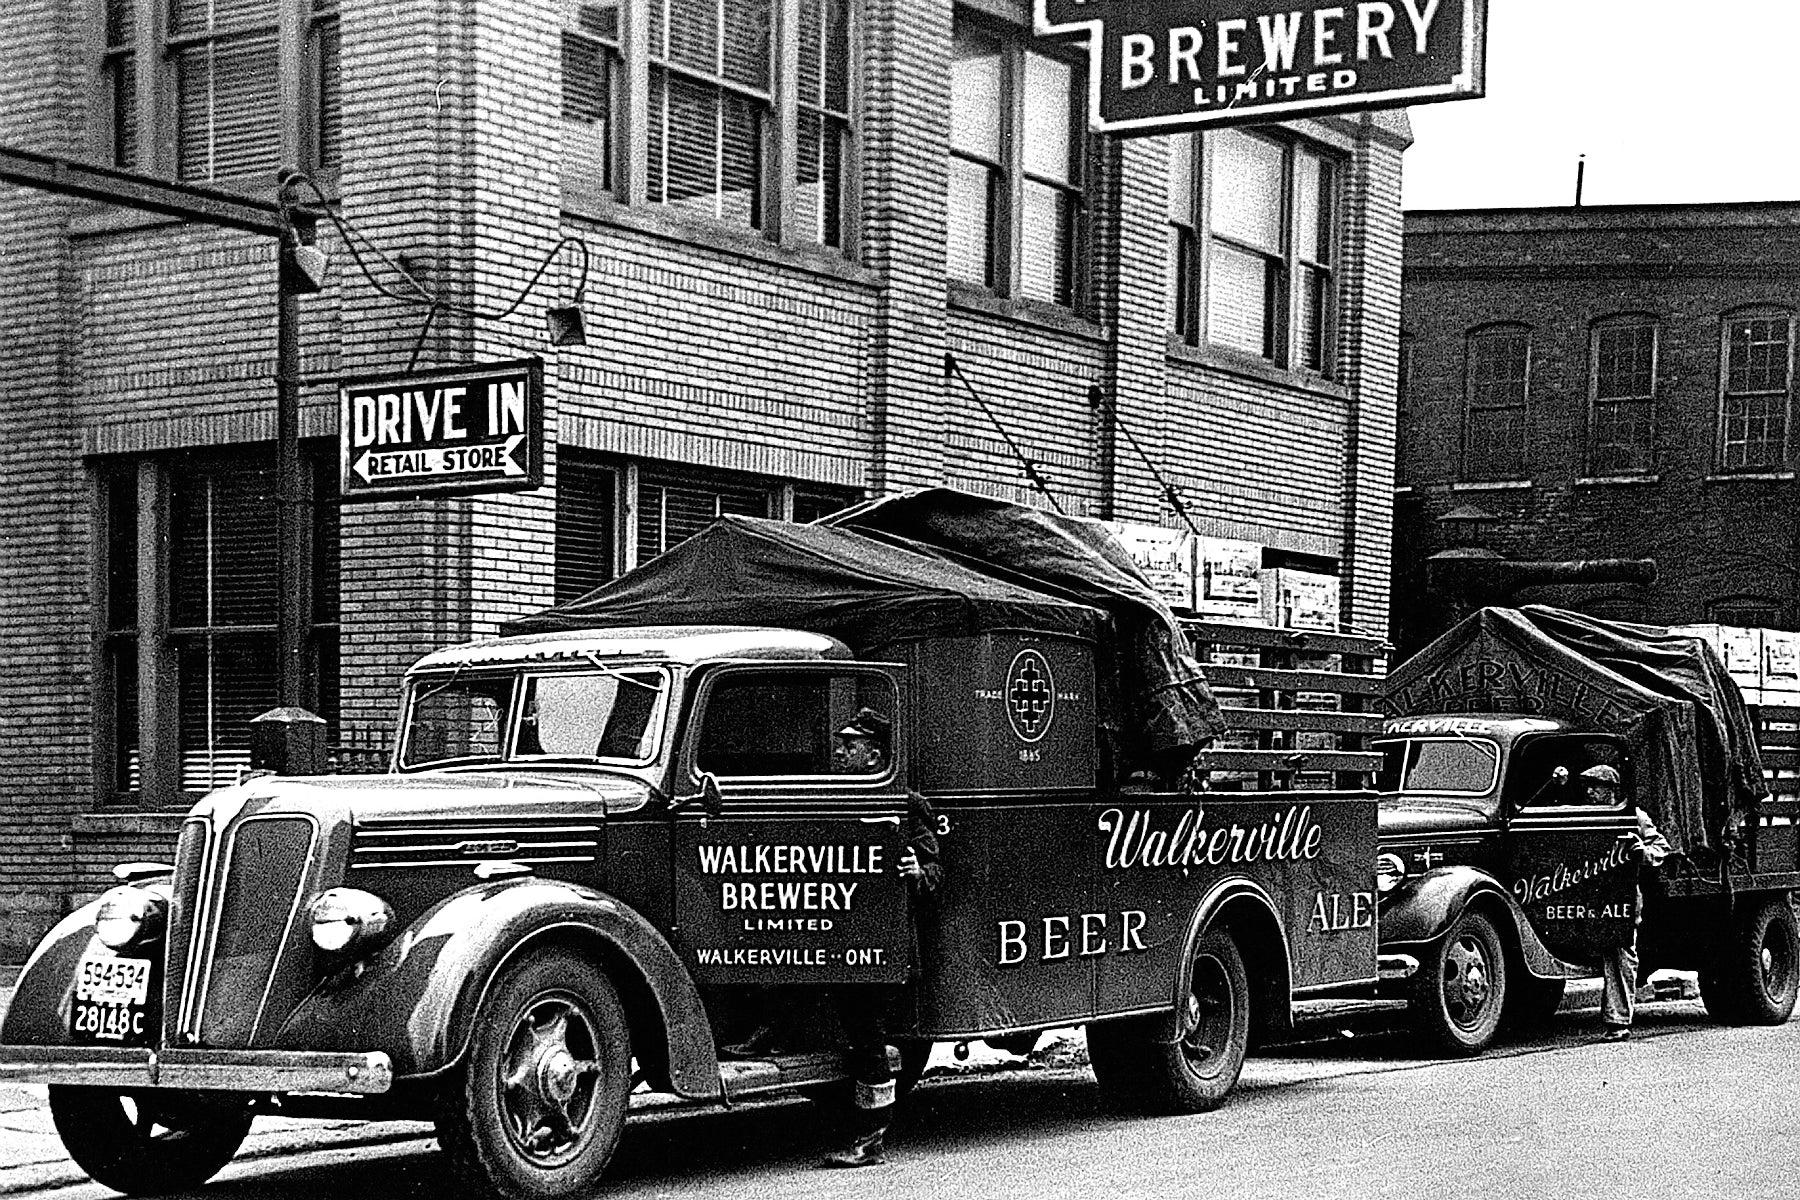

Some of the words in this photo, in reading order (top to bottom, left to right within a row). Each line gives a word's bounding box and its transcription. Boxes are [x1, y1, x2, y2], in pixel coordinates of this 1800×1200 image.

[1121, 0, 1440, 90] BREWERY
[1195, 69, 1357, 104] LIMITED
[354, 387, 467, 447] DRIVE
[488, 381, 525, 436] IN
[367, 453, 432, 476] RETAIL
[443, 446, 507, 470] STORE
[1098, 805, 1322, 876] Walkerville
[698, 845, 883, 874] WALKERVILLE
[722, 882, 858, 910] BREWERY
[1306, 890, 1373, 932] ALE
[1546, 905, 1586, 919] BEER
[1600, 903, 1631, 918] ALE
[744, 919, 833, 931] LIMITED
[998, 910, 1148, 965] BEER
[696, 949, 827, 966] WALKERVILLE
[75, 1005, 145, 1035] 28148C
